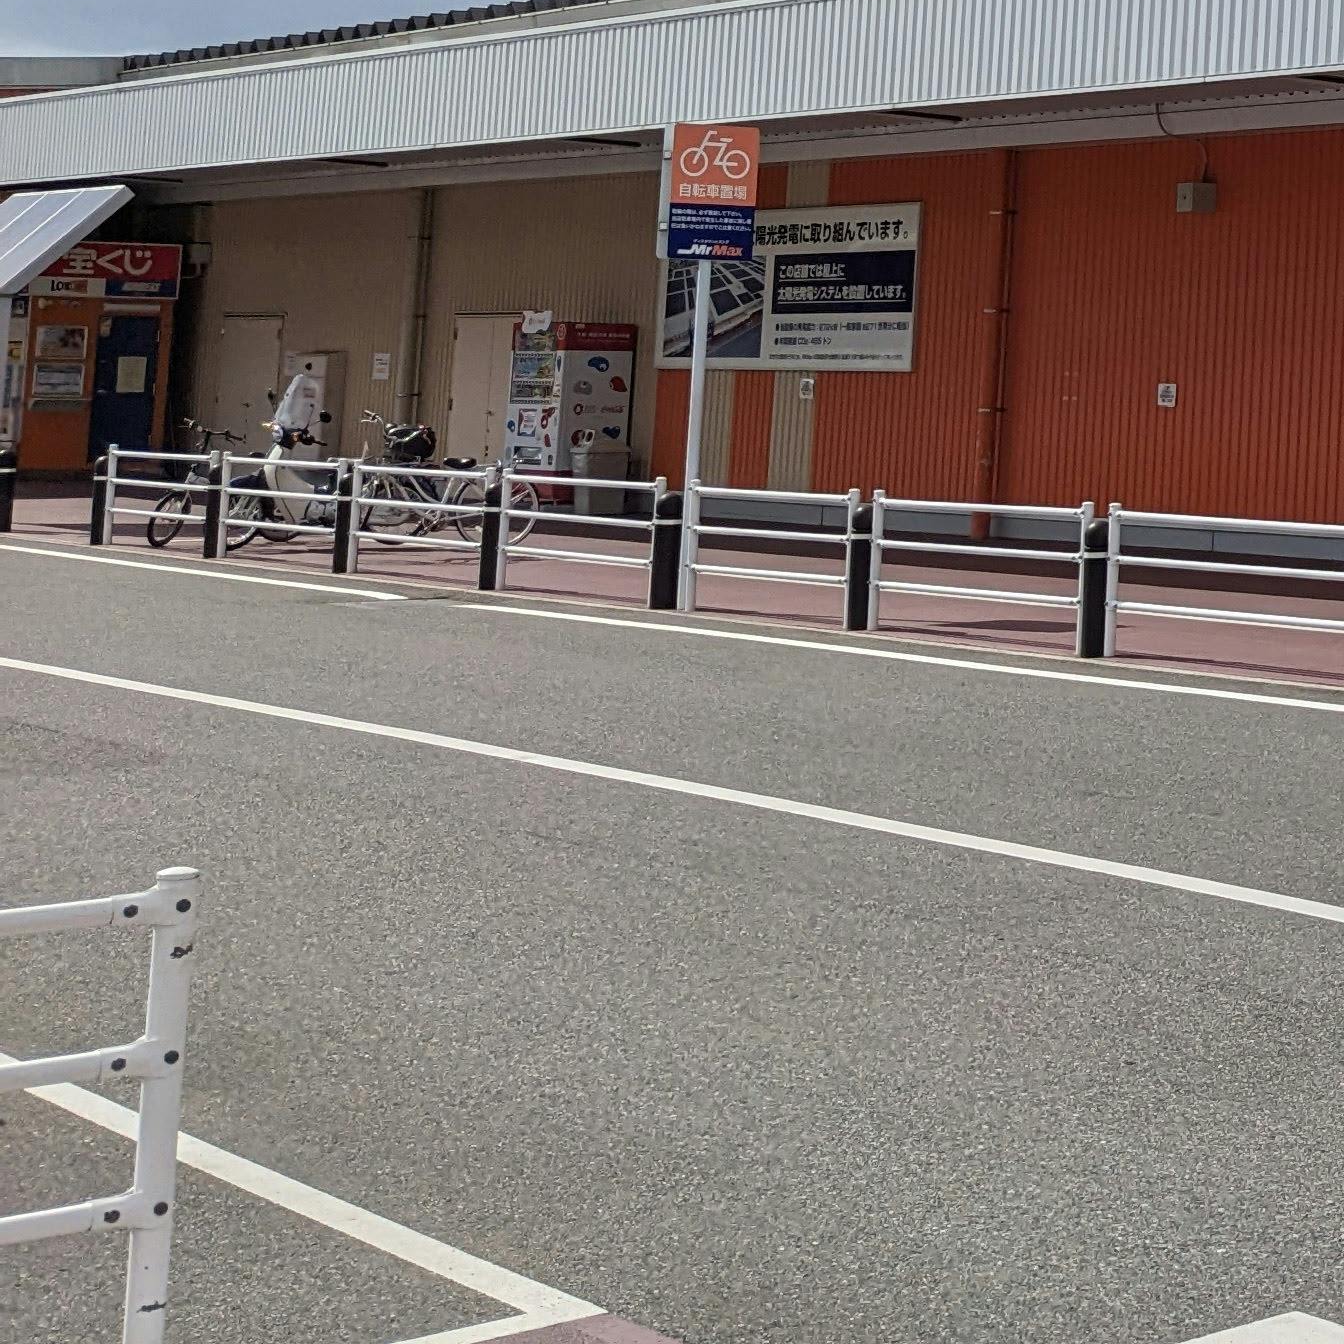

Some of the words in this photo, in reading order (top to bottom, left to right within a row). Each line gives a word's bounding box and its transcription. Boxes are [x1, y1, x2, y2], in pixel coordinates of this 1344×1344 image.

[679, 183, 747, 200] 自転車置場
[753, 219, 909, 246] 陽光発電に取り組んでいます。
[62, 247, 153, 275] 宝くじ
[676, 243, 744, 257] MrMax
